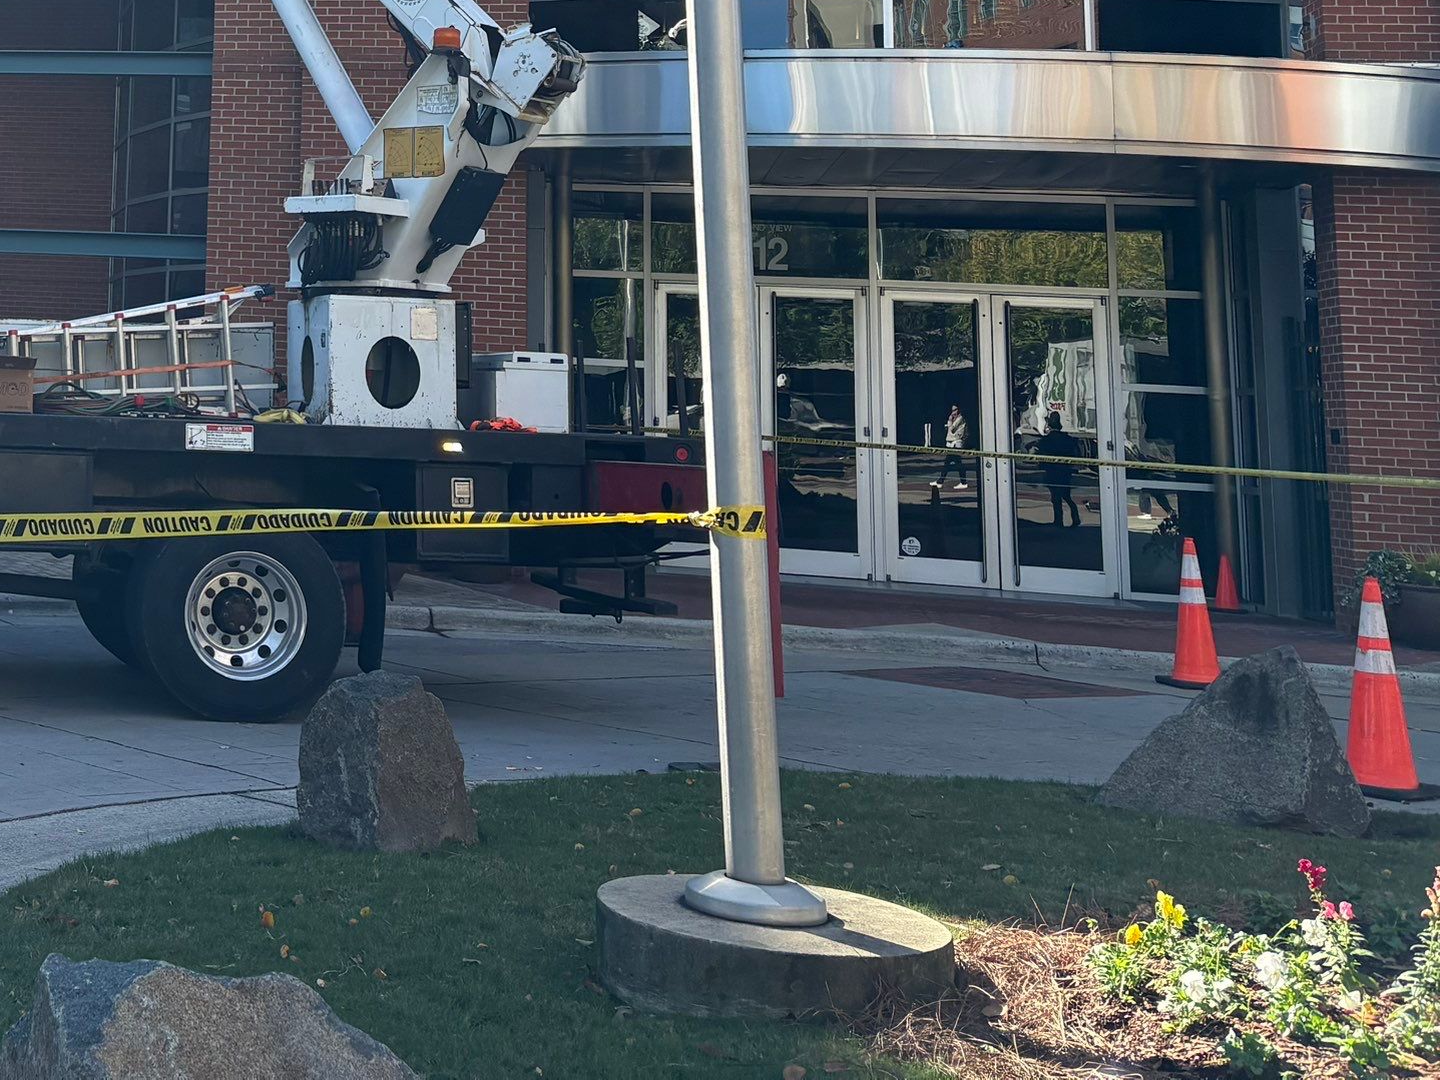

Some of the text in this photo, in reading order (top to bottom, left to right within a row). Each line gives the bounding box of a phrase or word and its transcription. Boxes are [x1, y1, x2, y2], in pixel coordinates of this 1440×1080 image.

[30, 518, 95, 537] CUIDADO
[144, 516, 211, 533] CAUTION
[257, 511, 333, 531] CUIDADO
